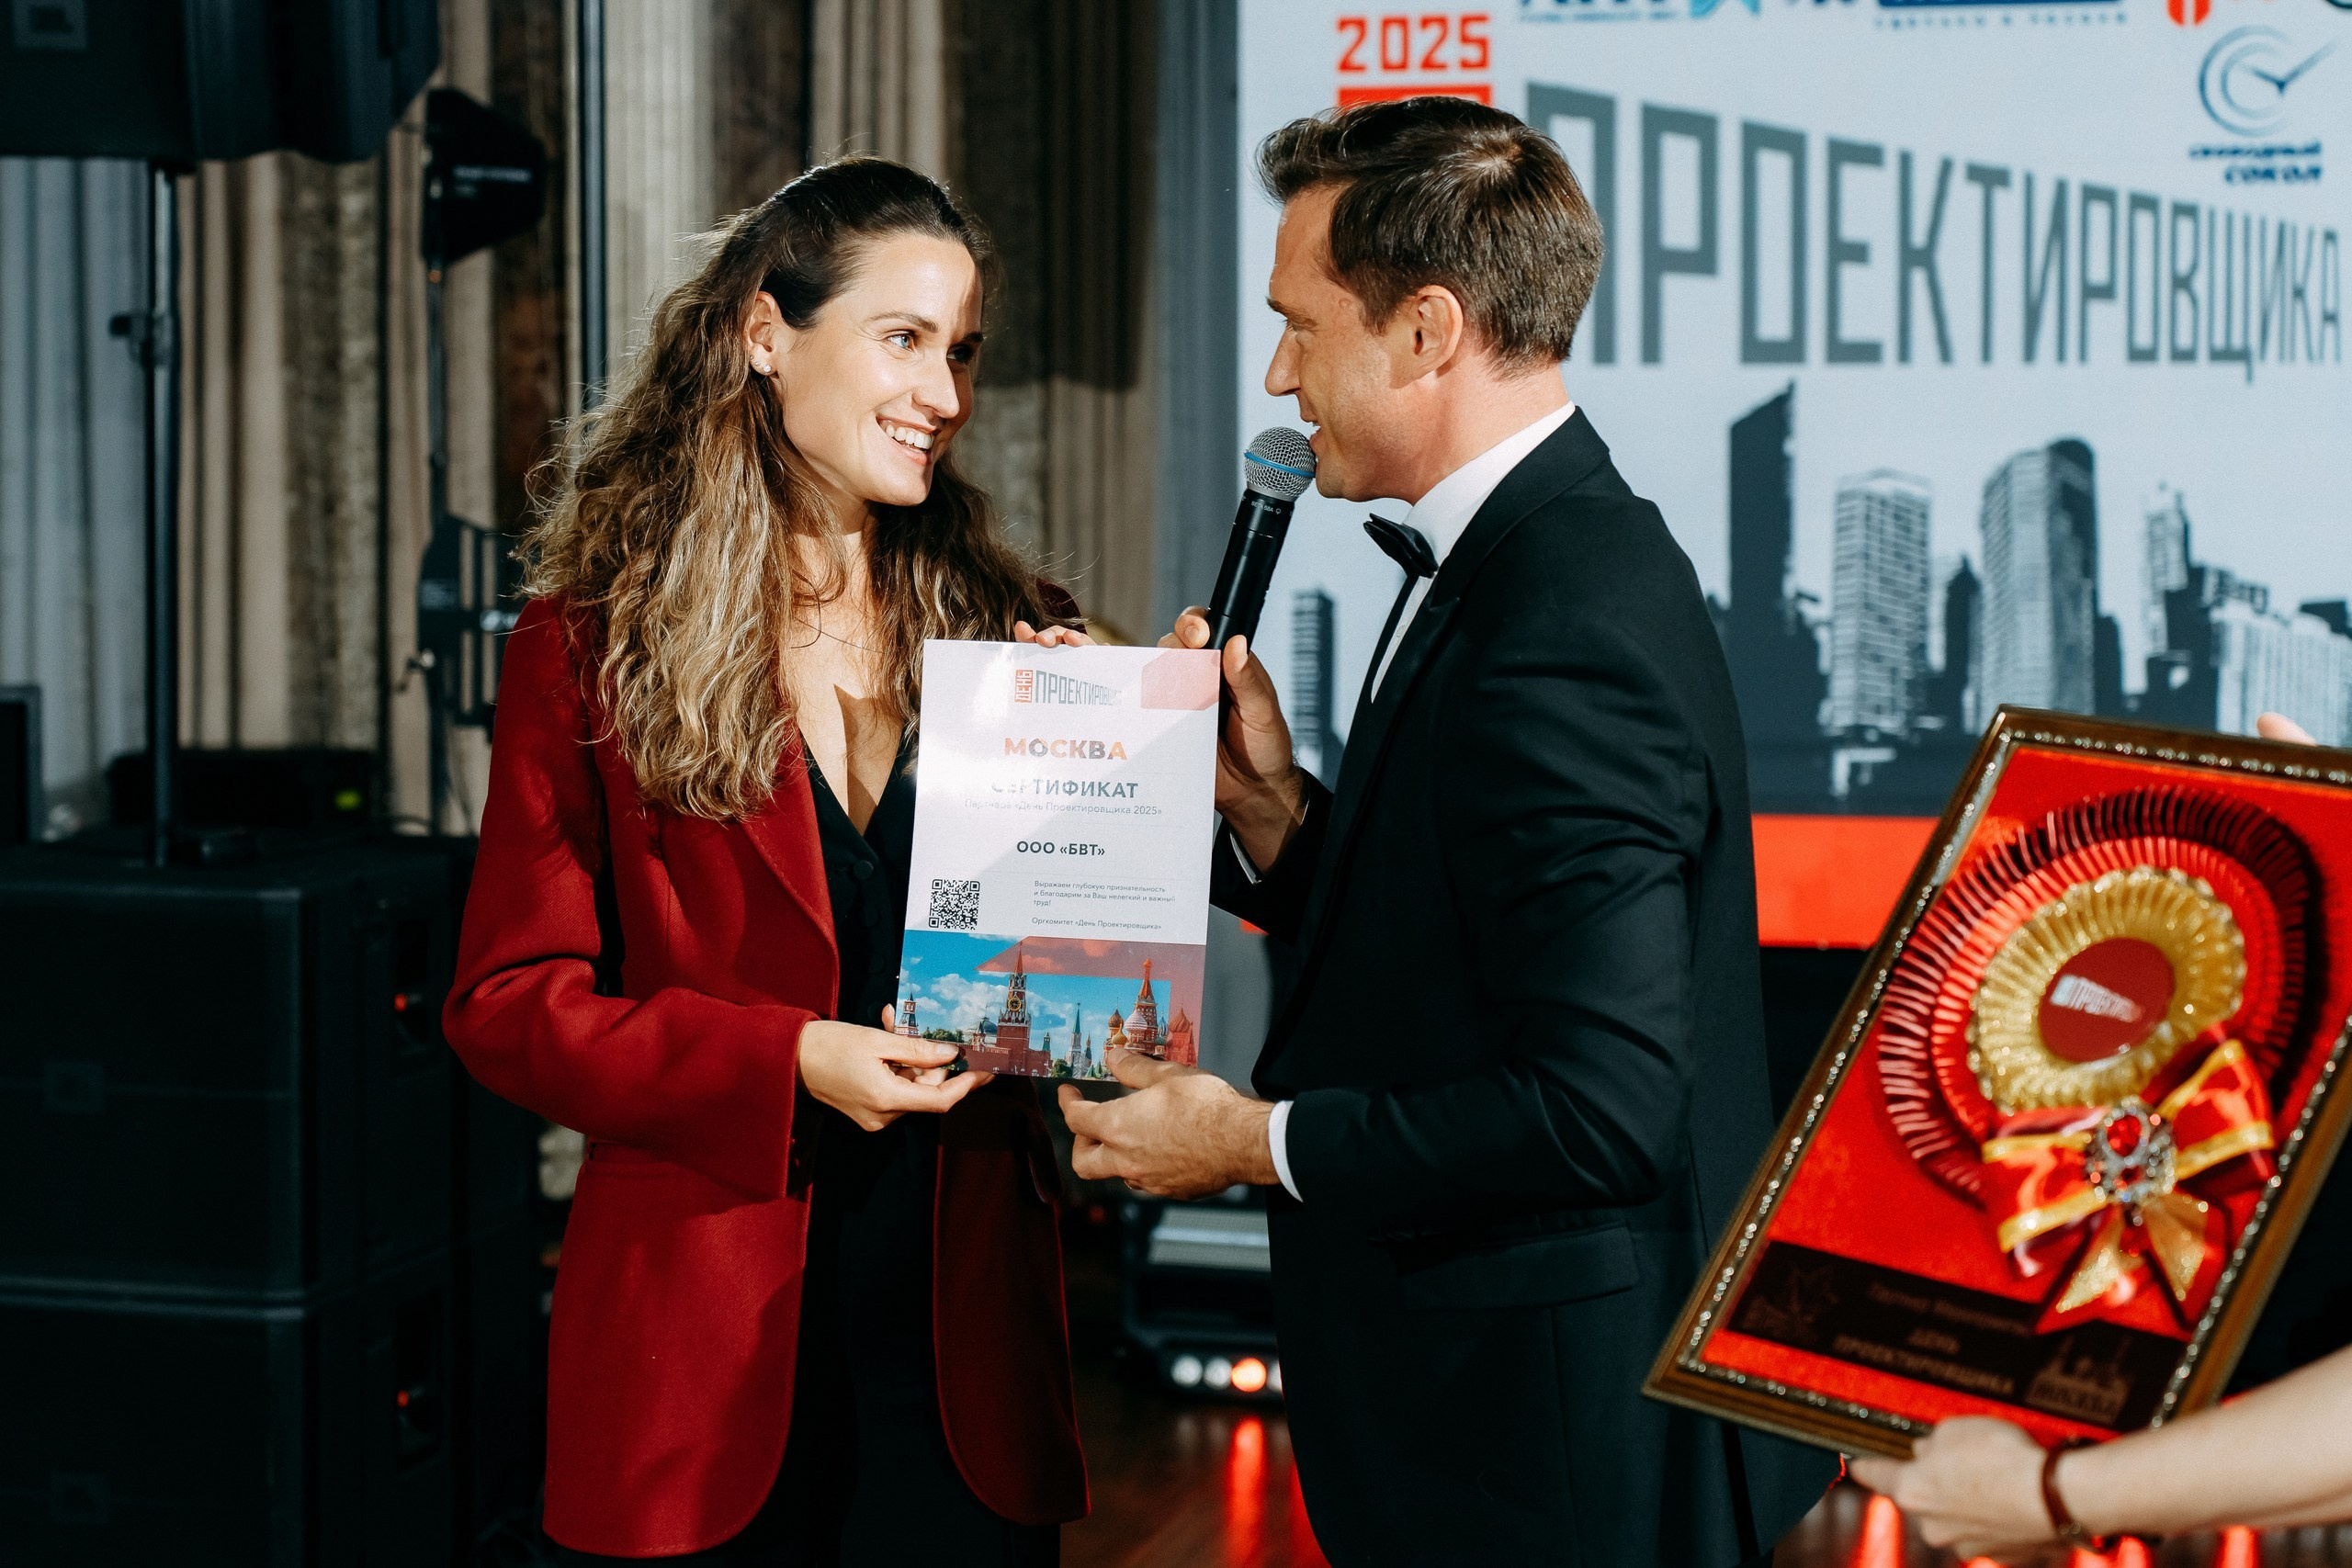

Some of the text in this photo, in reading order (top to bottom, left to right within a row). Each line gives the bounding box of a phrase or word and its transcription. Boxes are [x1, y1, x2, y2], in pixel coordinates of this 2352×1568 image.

[1337, 14, 1490, 72] 2025
[1525, 81, 2341, 382] ПРОЕКТИРОВЩИКА
[1003, 737, 1128, 761] МОСКВА
[1046, 802, 1131, 815] Проектировщика
[1133, 805, 1162, 816] 2025»
[1016, 840, 1105, 856] ООО «БВТ»
[1035, 880, 1166, 894] Выражаем глубокую признательность
[1040, 889, 1082, 899] благодарим
[1032, 917, 1162, 930] Оргкомитет «День Проектировщика»
